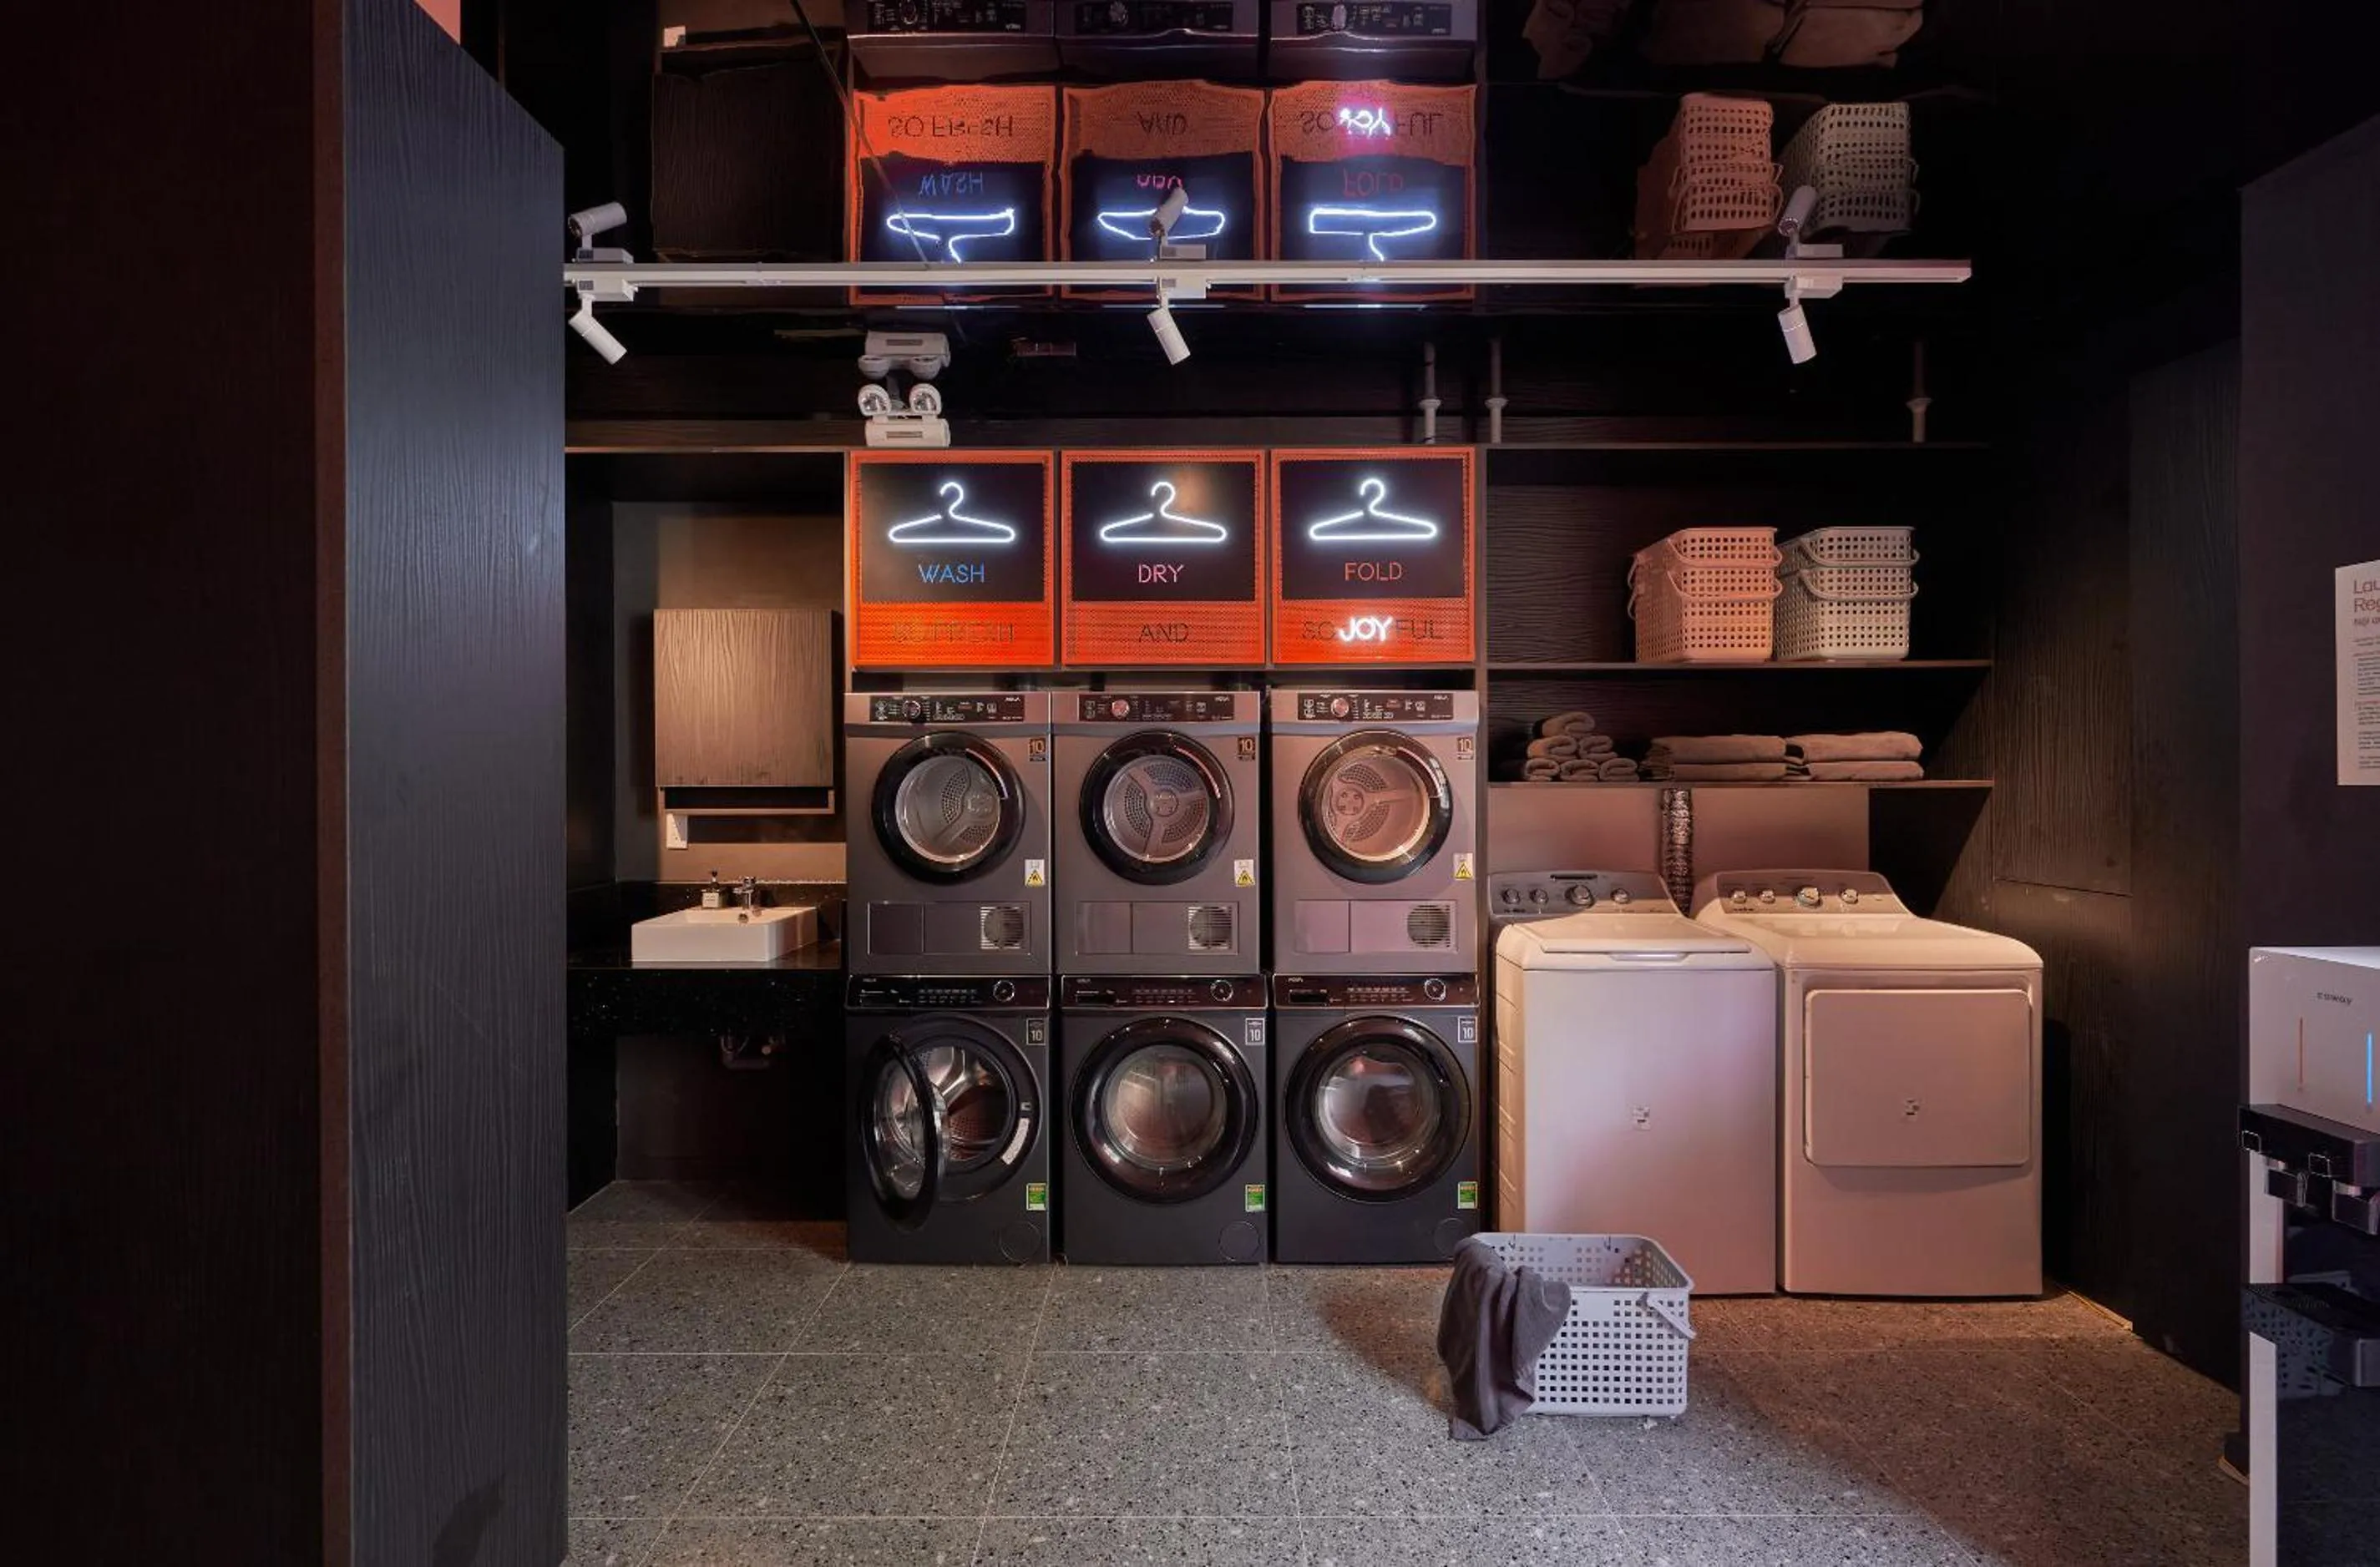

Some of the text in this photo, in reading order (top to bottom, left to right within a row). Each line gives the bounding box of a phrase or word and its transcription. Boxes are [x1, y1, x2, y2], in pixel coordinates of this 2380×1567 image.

[919, 563, 985, 584] WASH
[1138, 564, 1184, 584] DRY
[1344, 562, 1402, 582] FOLD
[1138, 623, 1189, 643] AND
[1030, 739, 1044, 754] 10
[1240, 738, 1253, 752] 10
[1459, 738, 1471, 751] 10
[1030, 1030, 1043, 1042] 10
[1249, 1029, 1261, 1042] 10
[1463, 1027, 1473, 1040] 10
